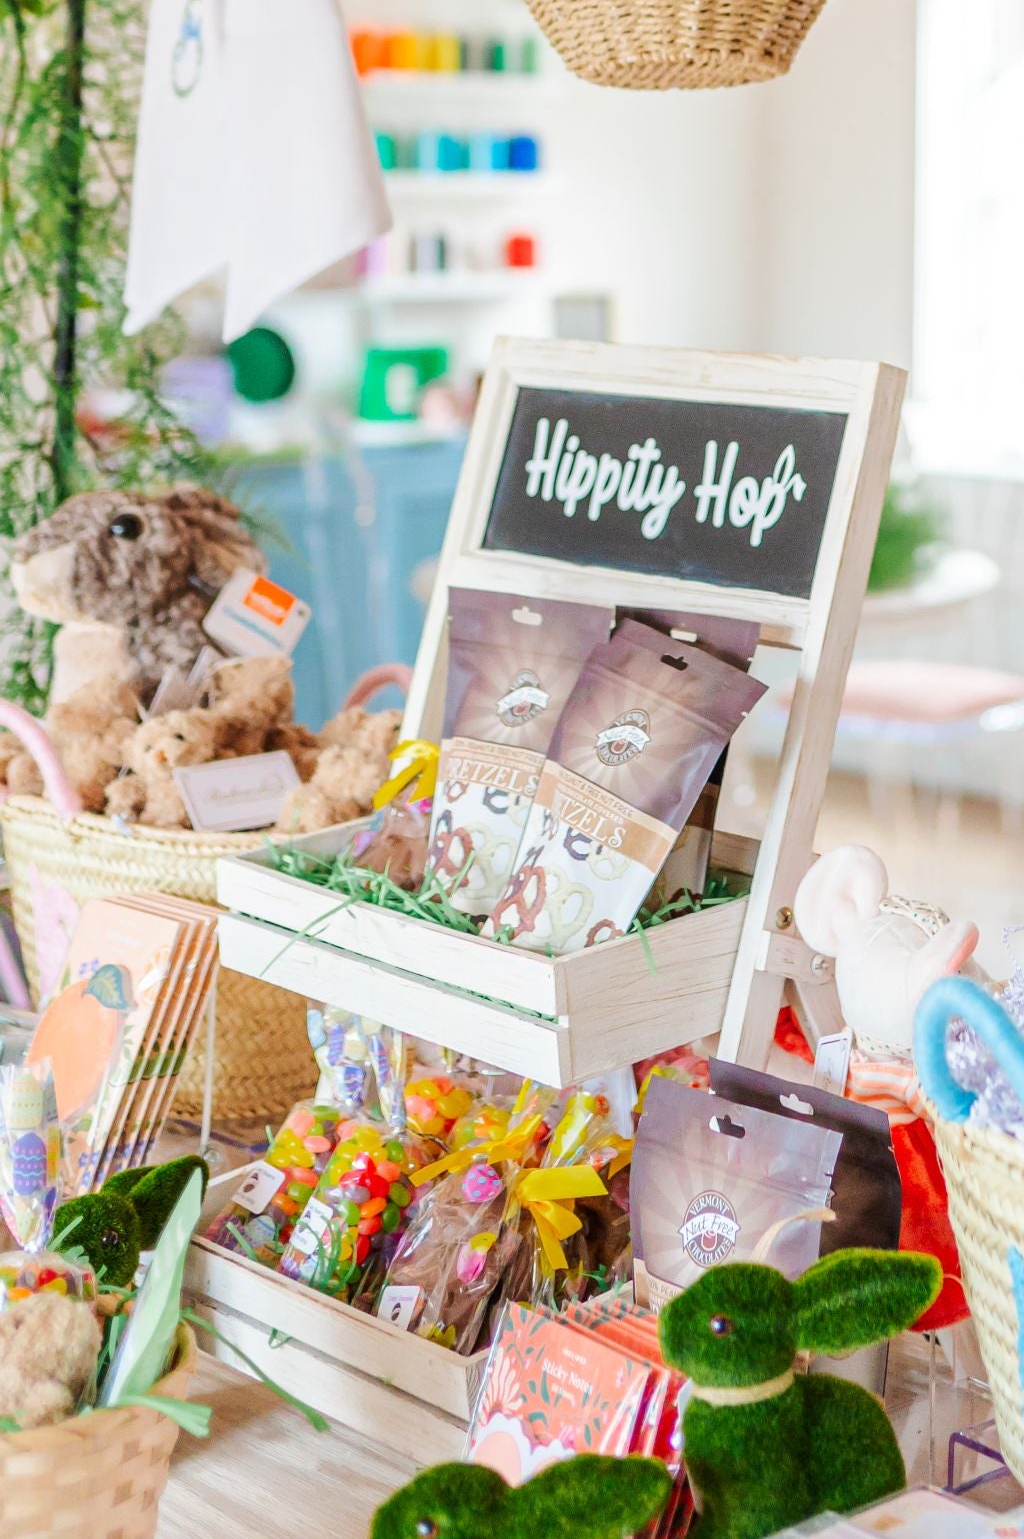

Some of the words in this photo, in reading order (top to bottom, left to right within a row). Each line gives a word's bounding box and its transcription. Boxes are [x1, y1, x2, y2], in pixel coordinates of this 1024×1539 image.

[525, 417, 686, 540] Hippity
[693, 440, 807, 547] Hop
[614, 801, 634, 818] FREE
[690, 1194, 730, 1215] VERMONT
[686, 1215, 706, 1241] Nut
[711, 1215, 734, 1237] Free
[688, 1238, 733, 1263] CHOCOLATES
[542, 1357, 568, 1384] Sticky
